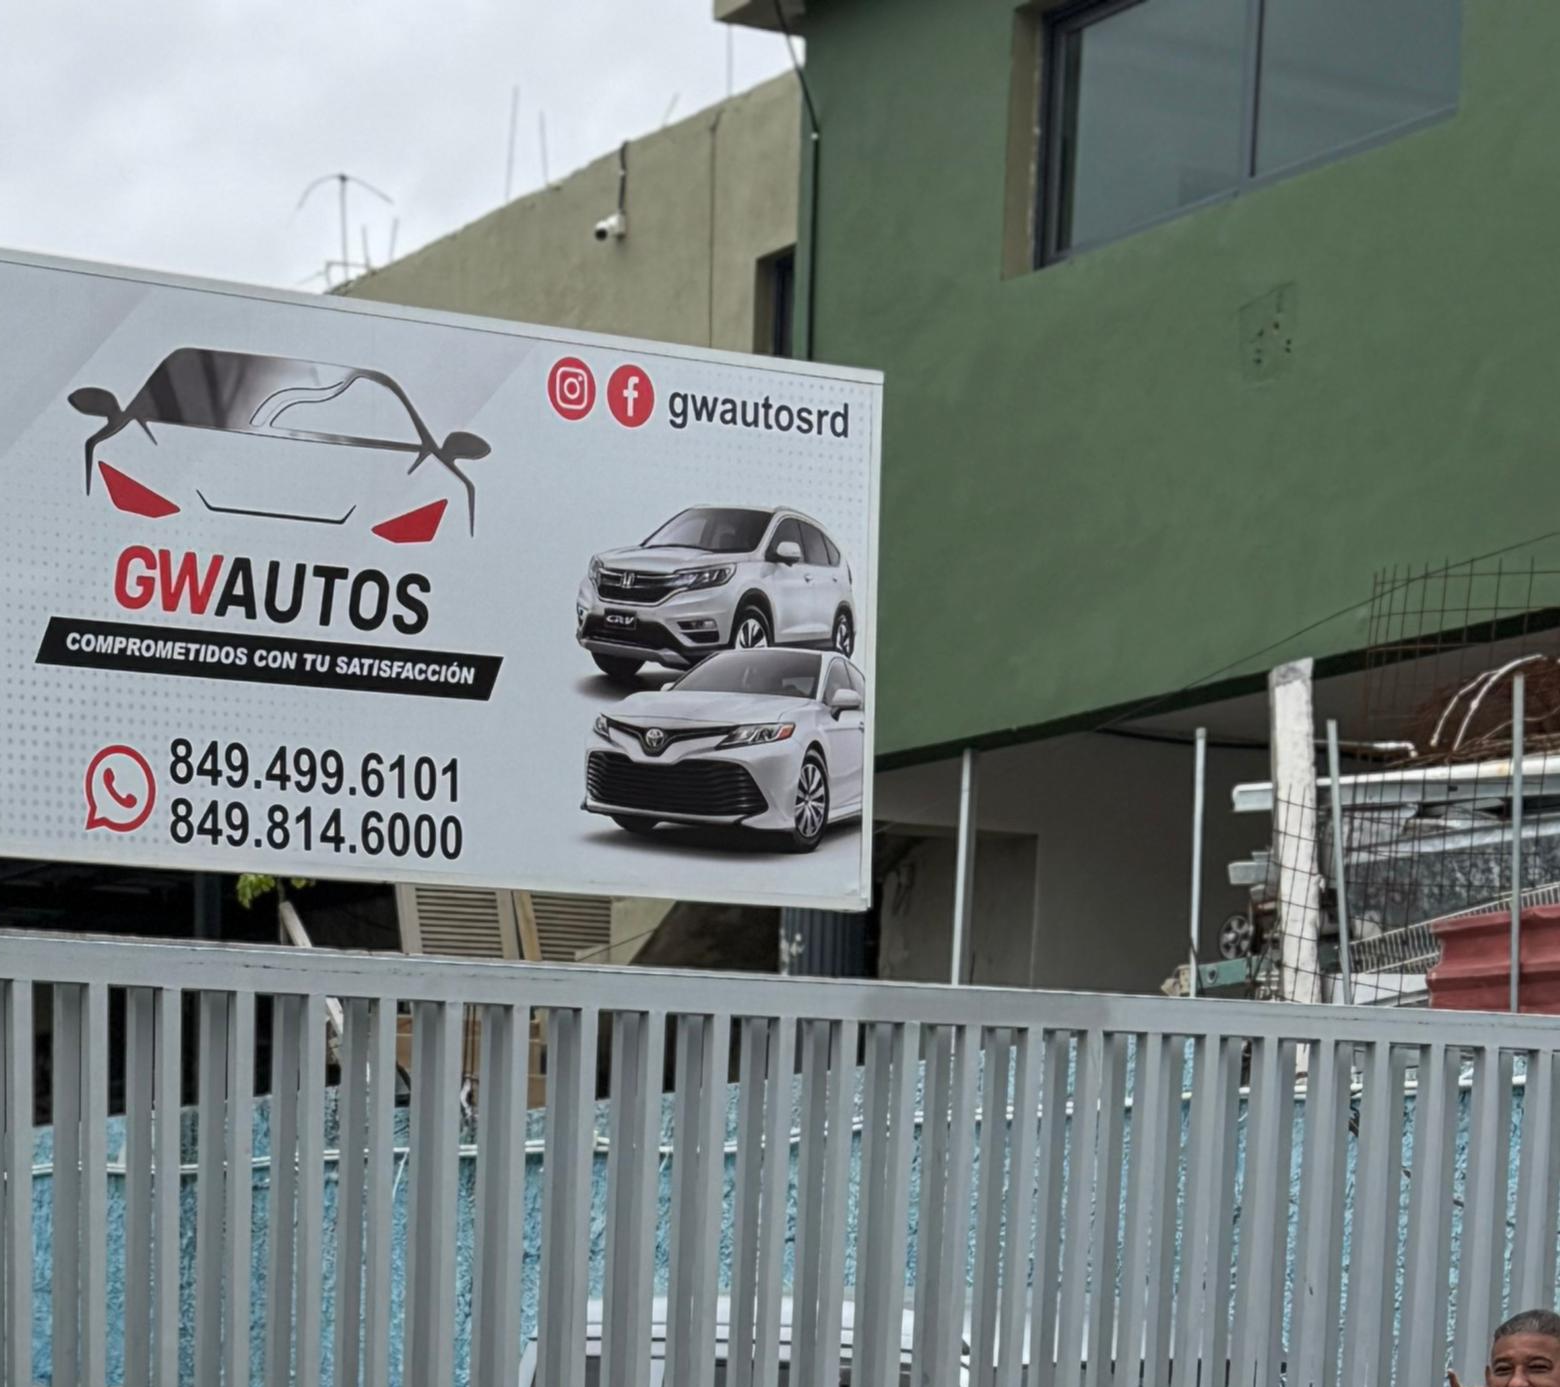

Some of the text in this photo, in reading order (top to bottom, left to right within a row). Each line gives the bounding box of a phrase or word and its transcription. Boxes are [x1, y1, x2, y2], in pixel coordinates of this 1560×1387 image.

[668, 391, 849, 439] gwautosrd
[114, 545, 431, 635] GWAUTOS
[66, 632, 476, 685] COMPROMETIDOS CON TU SATISFACCIÓN
[169, 737, 458, 803] 849.499.6101
[170, 797, 463, 860] 849.814.6000
